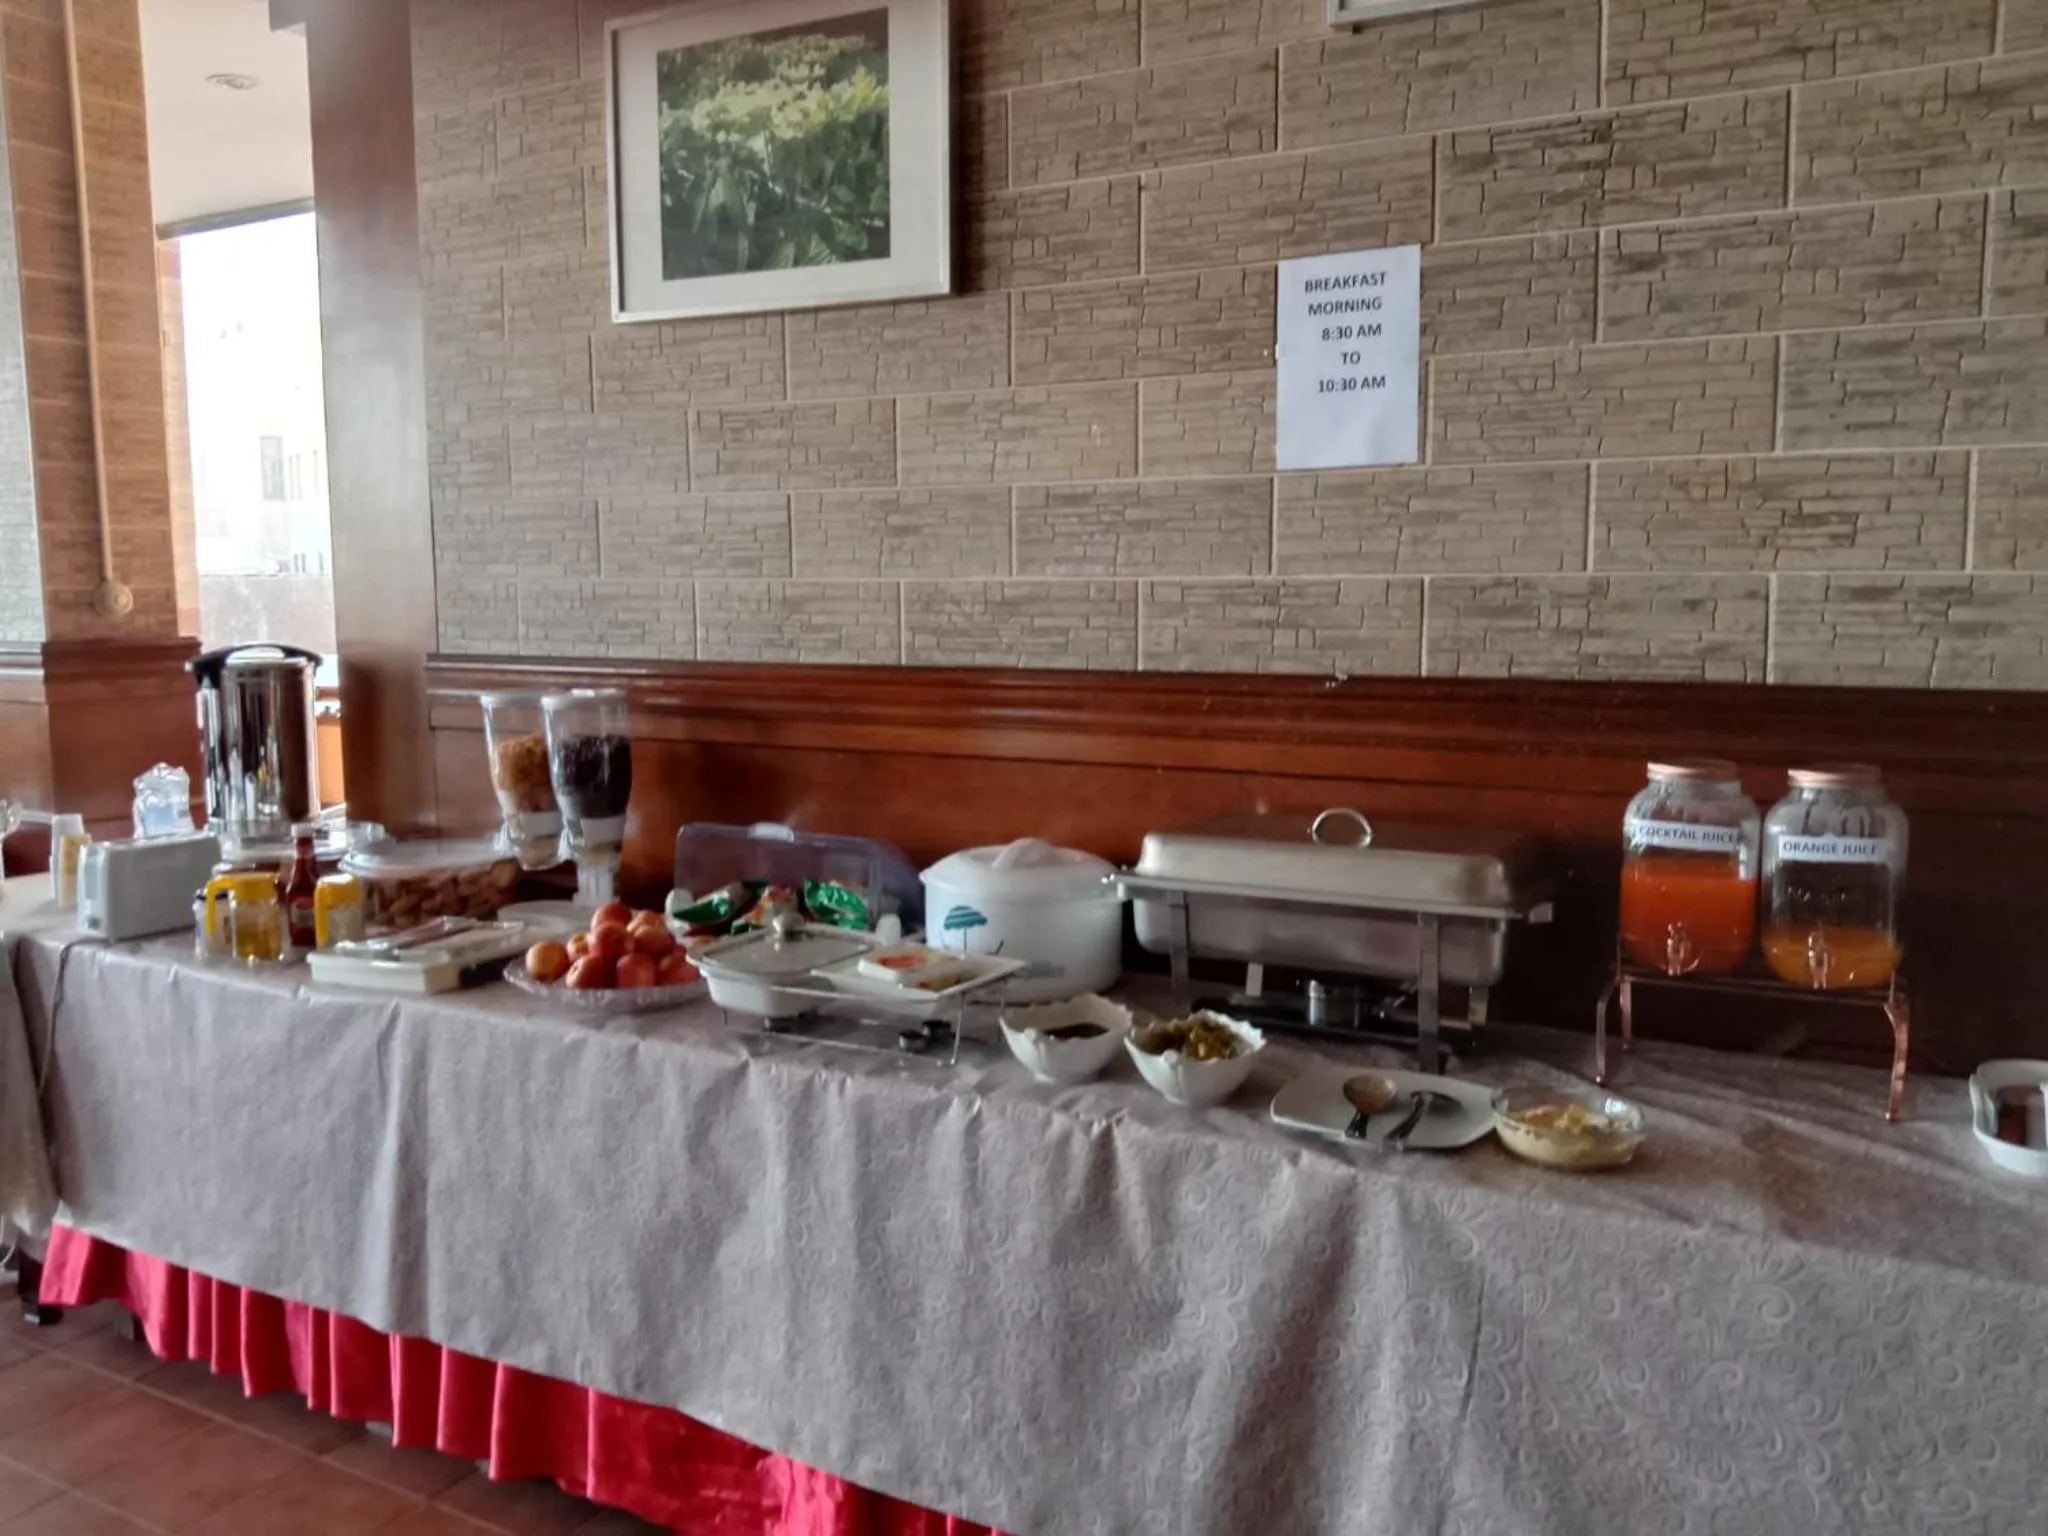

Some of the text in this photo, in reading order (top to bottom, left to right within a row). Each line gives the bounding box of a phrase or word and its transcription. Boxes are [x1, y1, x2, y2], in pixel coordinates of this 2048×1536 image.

[1305, 271, 1387, 293] BREAKFAST
[1308, 296, 1382, 316] MORNING
[1321, 323, 1382, 341] 8:30 AM
[1341, 351, 1361, 365] TO
[1318, 375, 1386, 393] 10:30 AM
[1639, 826, 1697, 841] COCKTAIL
[1783, 840, 1876, 856] ORANGE JUICE
